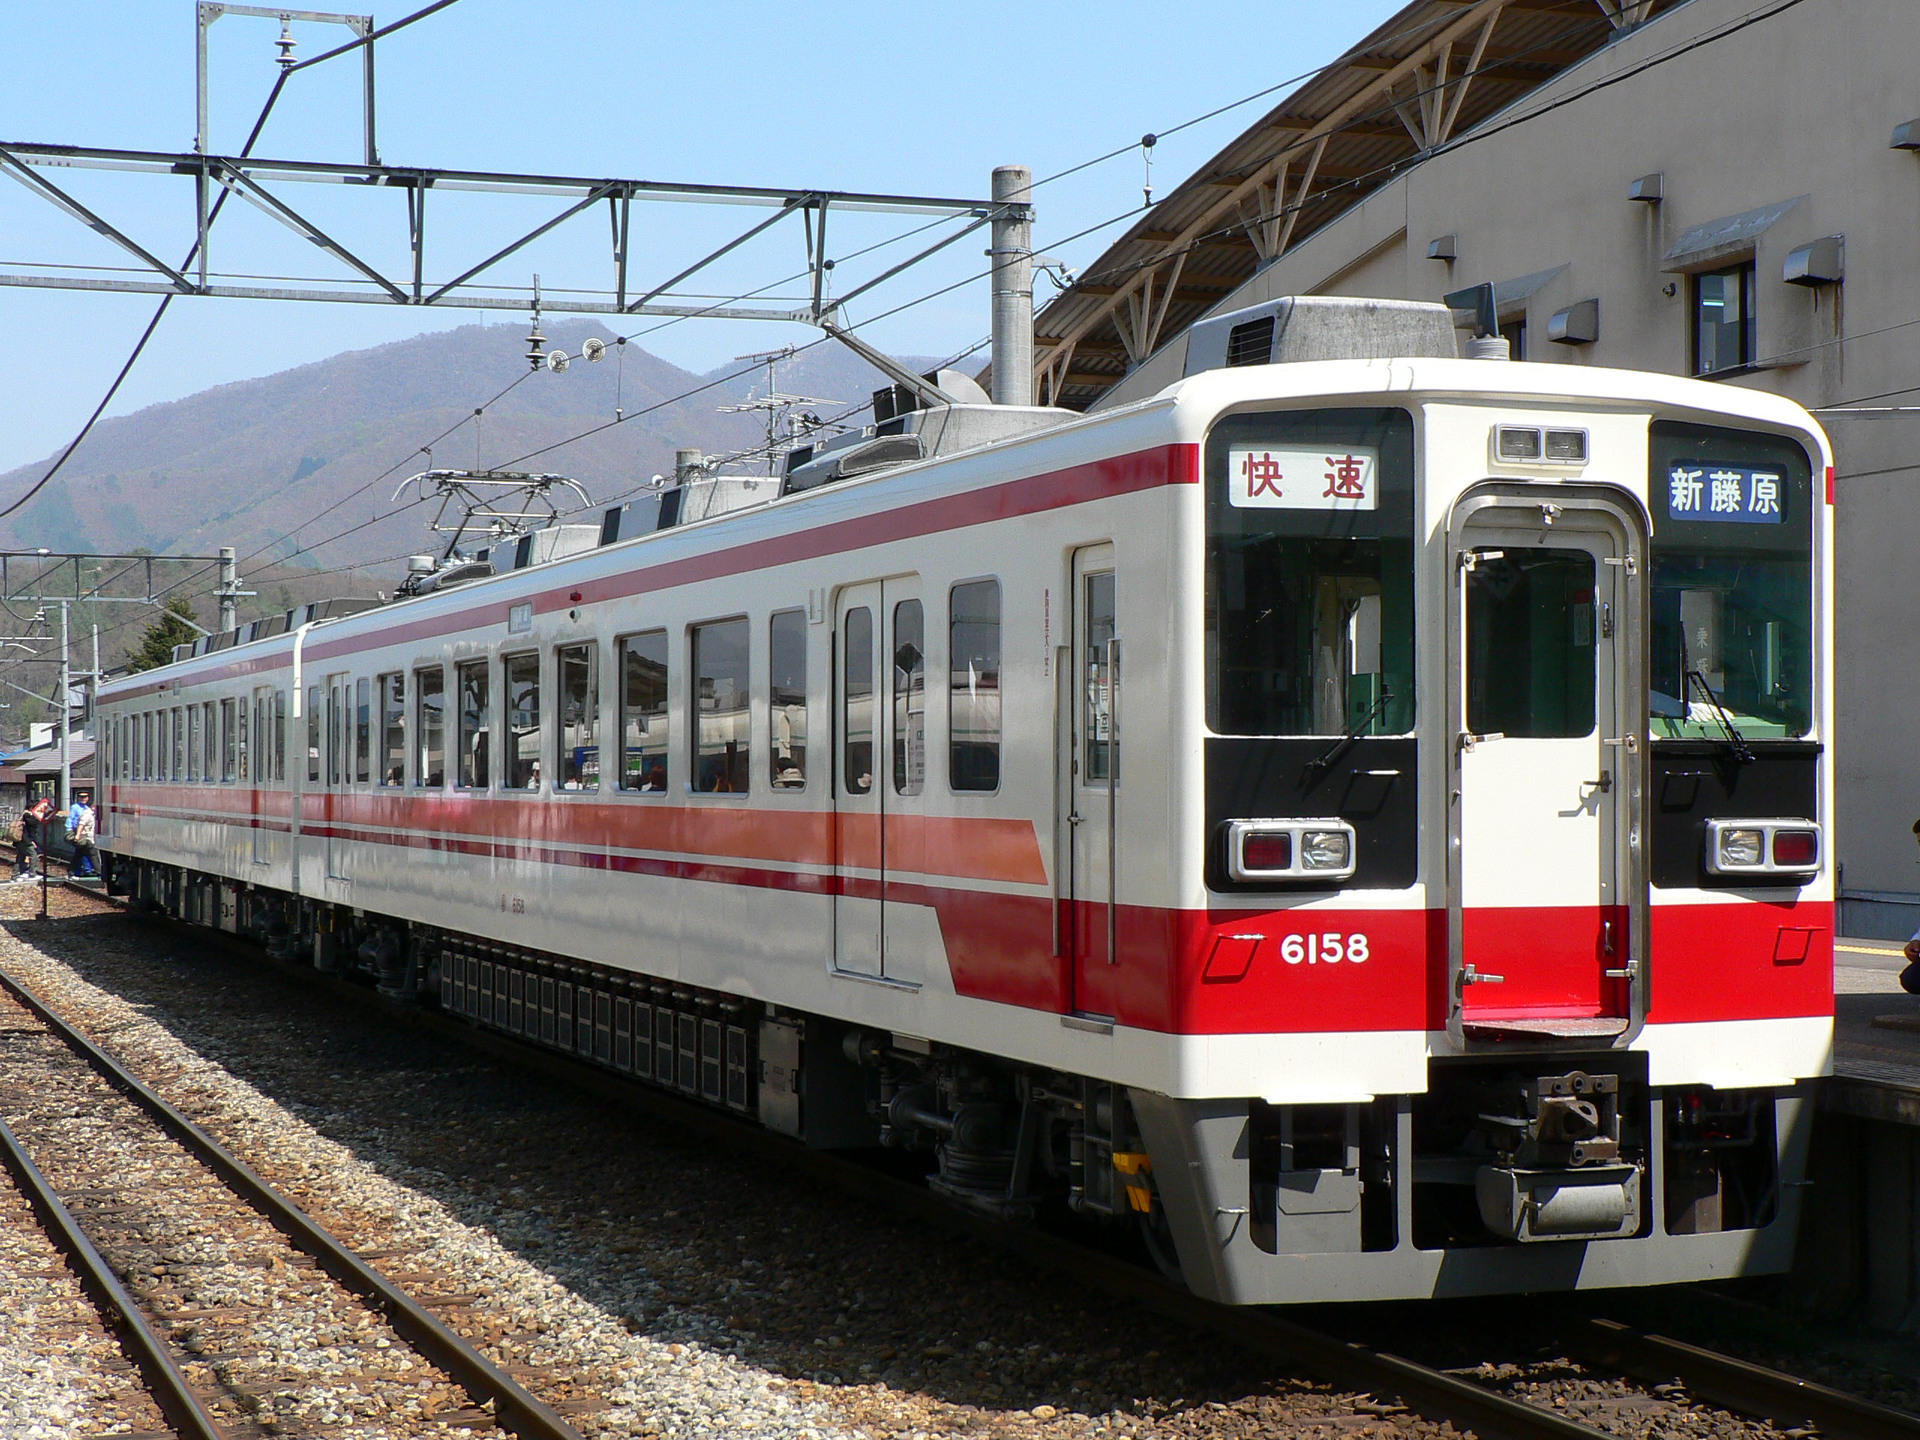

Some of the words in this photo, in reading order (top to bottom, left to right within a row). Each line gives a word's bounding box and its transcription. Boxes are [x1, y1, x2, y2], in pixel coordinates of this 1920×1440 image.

[1242, 452, 1365, 499] 快速
[1670, 467, 1780, 515] 新藤原
[1280, 932, 1370, 965] 6158
